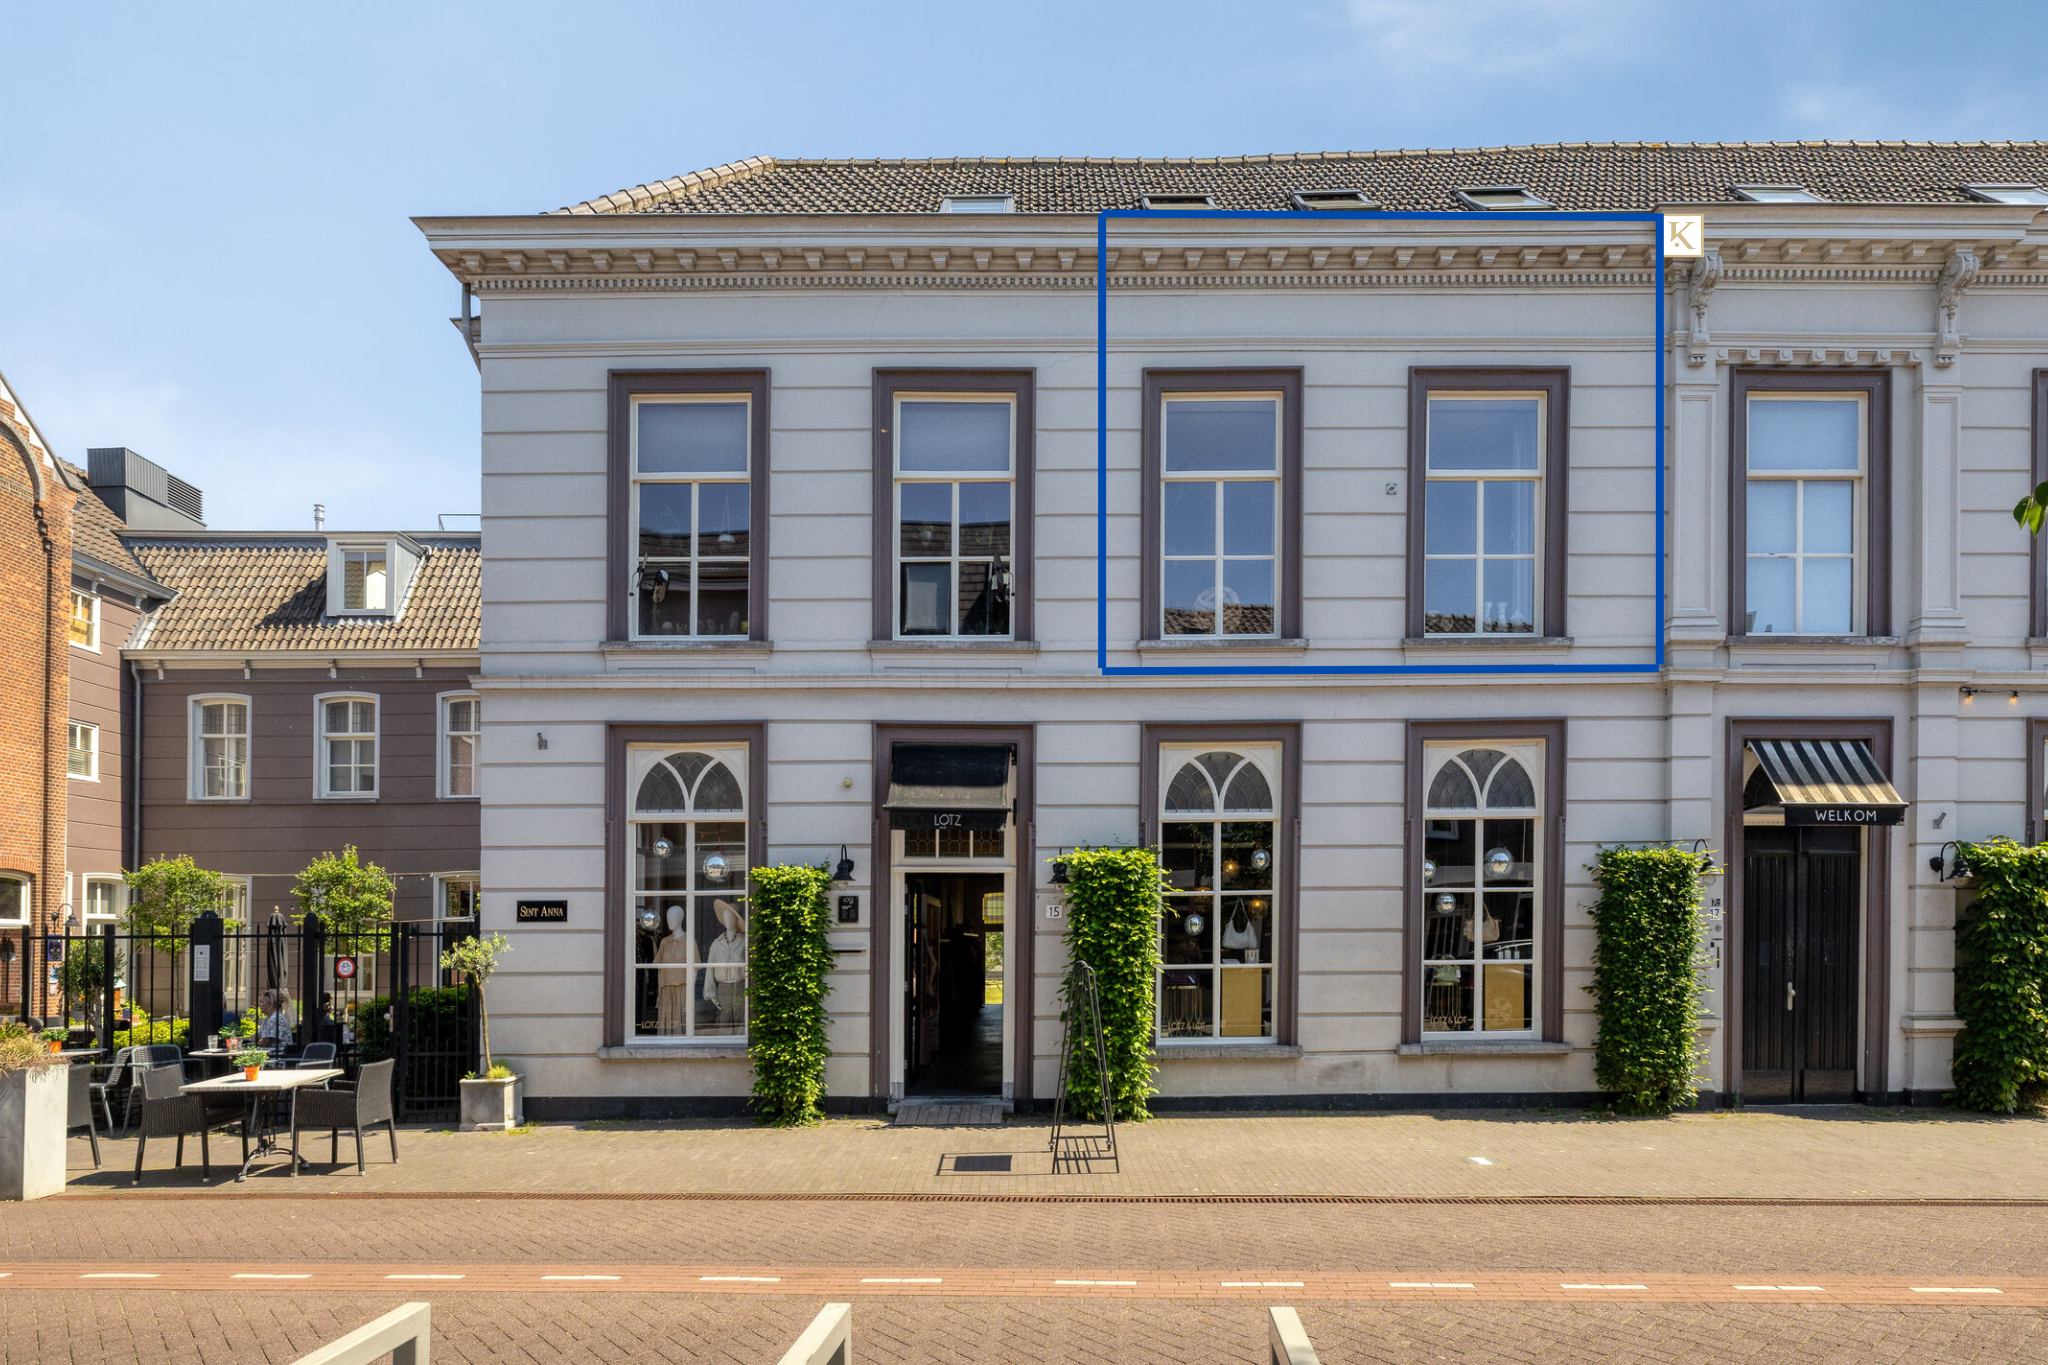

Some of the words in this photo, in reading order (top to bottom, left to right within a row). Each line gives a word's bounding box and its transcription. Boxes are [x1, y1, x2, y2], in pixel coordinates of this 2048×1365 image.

[934, 814, 962, 826] LOTZ
[1815, 810, 1877, 821] WELKOM
[520, 905, 539, 917] SINT
[541, 905, 564, 917] ANNA
[1049, 906, 1060, 917] 15
[1711, 908, 1720, 919] 17
[641, 1021, 659, 1029] LOTZ
[1168, 1022, 1185, 1030] LOTZ
[1192, 1021, 1205, 1030] LOT
